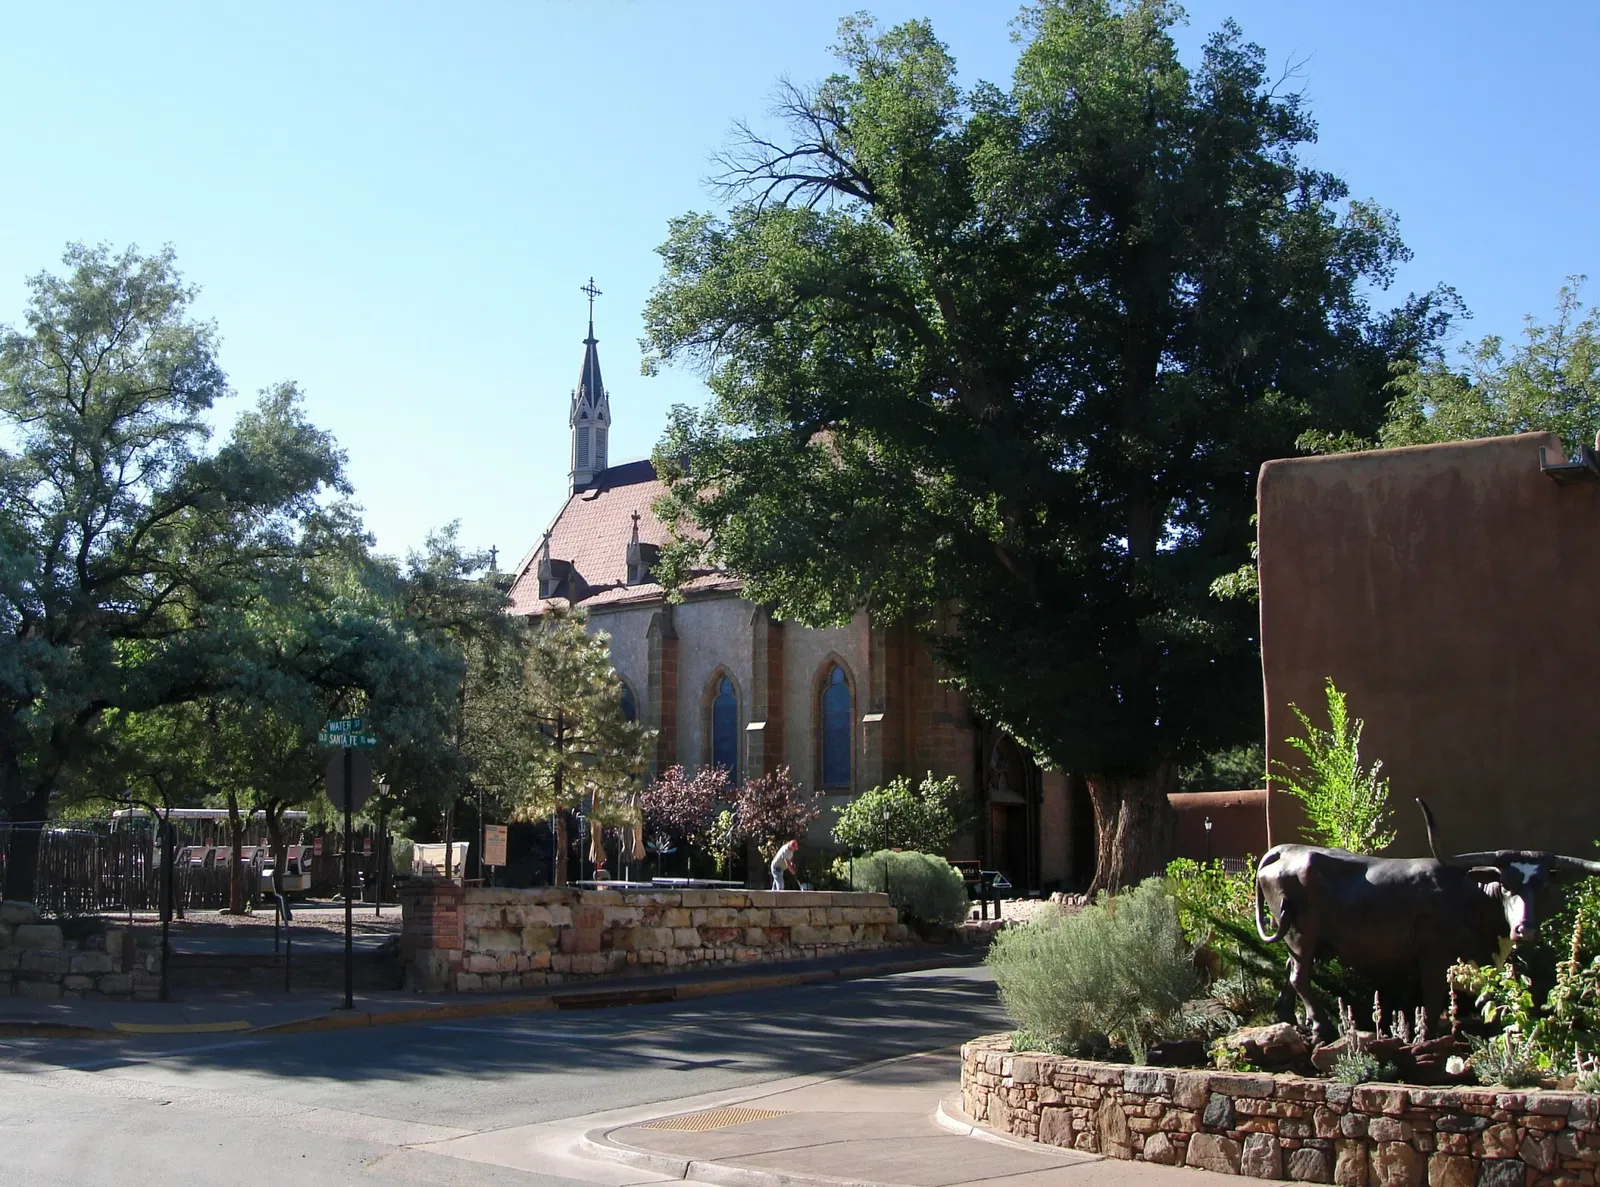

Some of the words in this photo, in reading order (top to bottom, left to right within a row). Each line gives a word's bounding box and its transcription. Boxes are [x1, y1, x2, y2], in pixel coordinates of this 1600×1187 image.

[329, 720, 352, 732] WATER
[354, 720, 360, 728] ST
[318, 733, 328, 741] OLD
[329, 734, 347, 745] SANTA
[350, 736, 358, 746] FE
